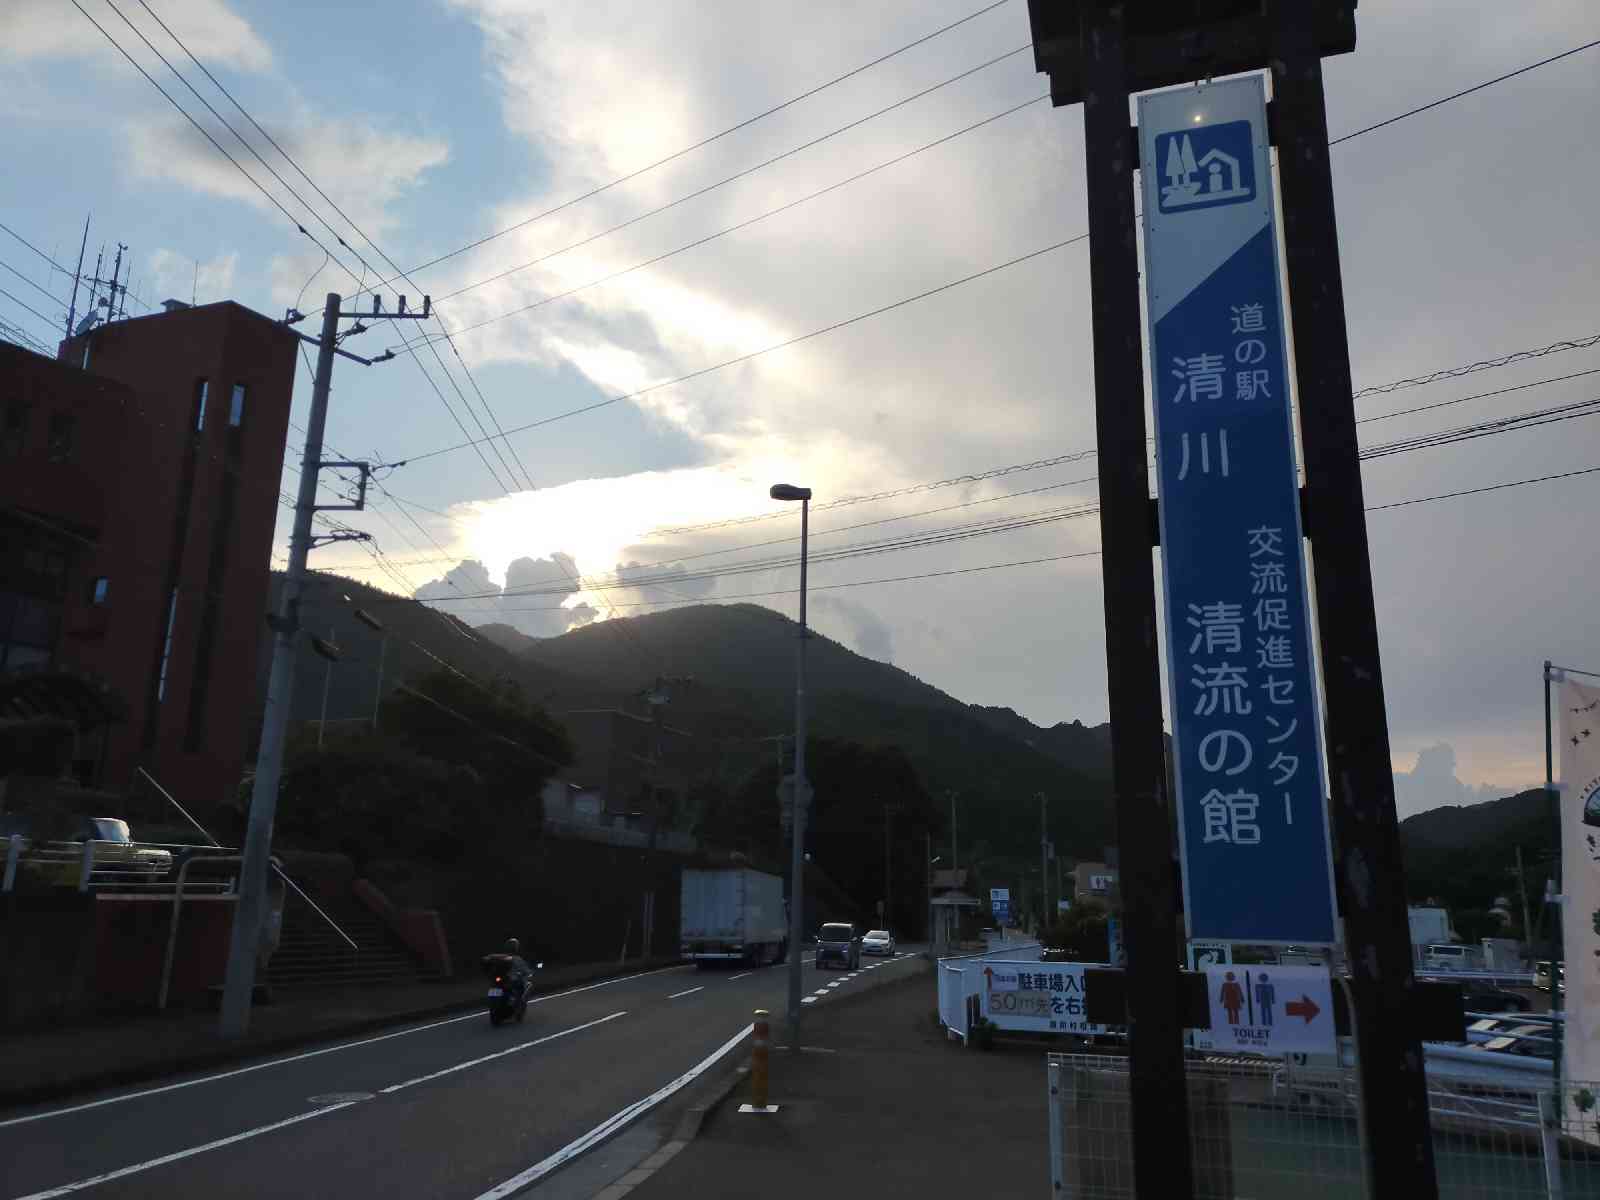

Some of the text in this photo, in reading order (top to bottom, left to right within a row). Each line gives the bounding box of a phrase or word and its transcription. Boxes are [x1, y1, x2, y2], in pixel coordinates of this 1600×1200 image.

[1231, 302, 1272, 401] 道の駅
[1171, 353, 1229, 481] 清川
[1186, 601, 1261, 844] 清流の館
[1248, 524, 1299, 825] 交流促進センター
[1232, 1028, 1271, 1039] TOILET
